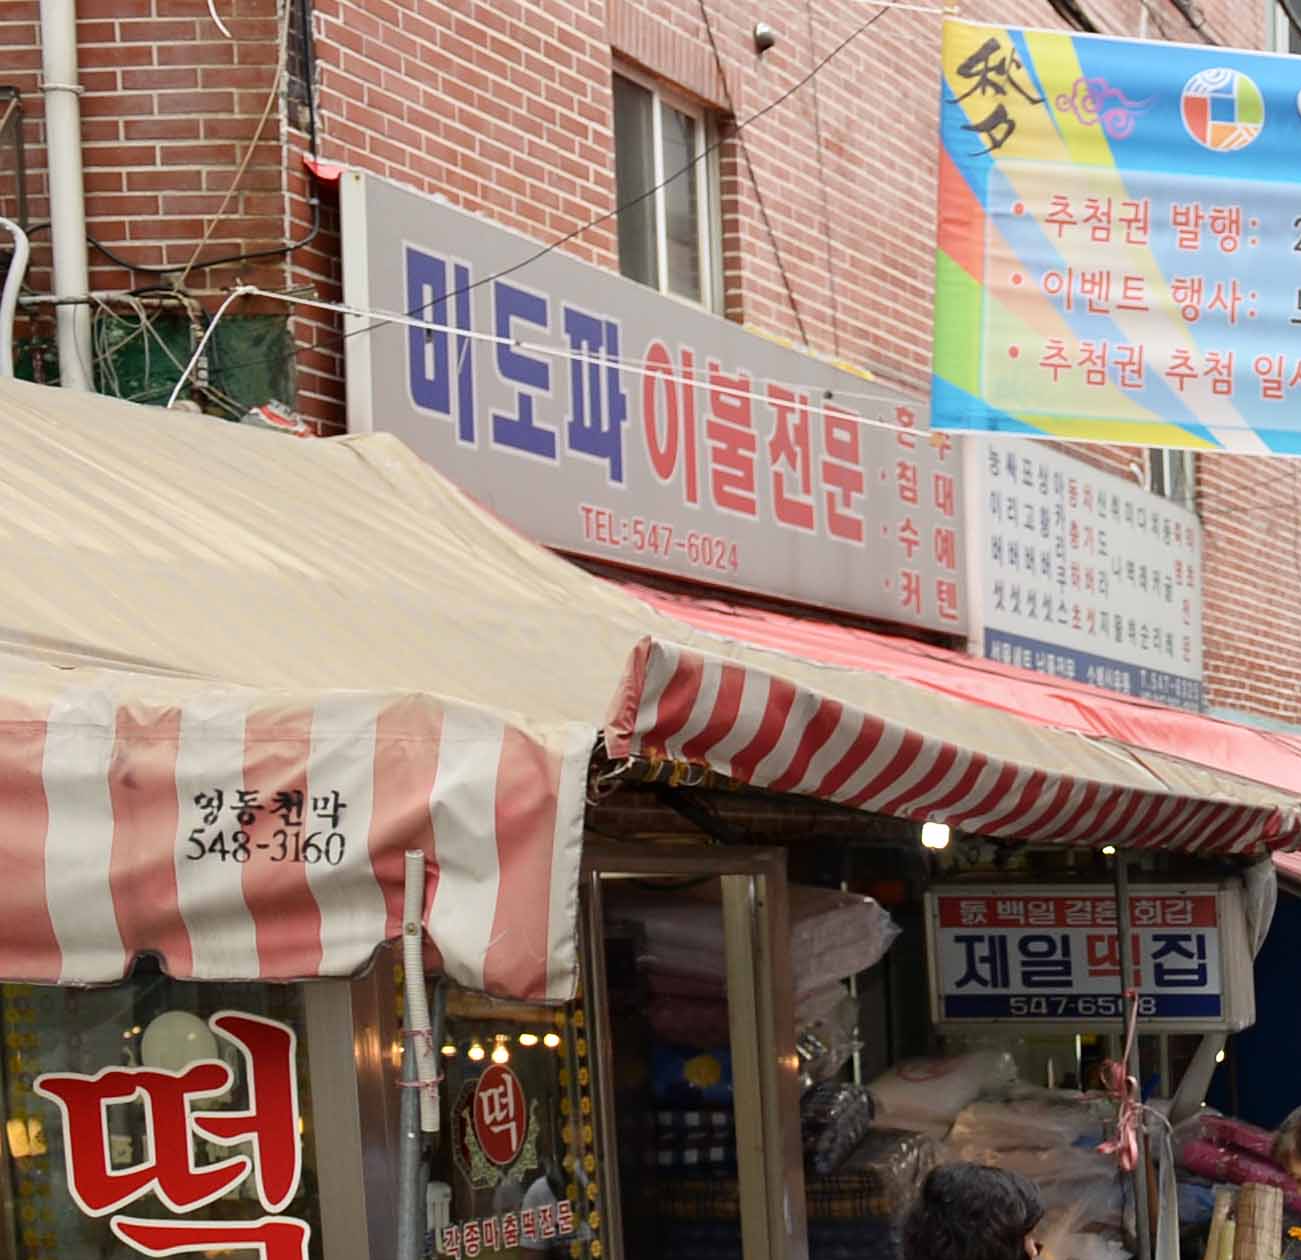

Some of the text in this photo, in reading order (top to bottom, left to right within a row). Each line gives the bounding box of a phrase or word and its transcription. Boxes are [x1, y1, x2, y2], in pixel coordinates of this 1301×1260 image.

[1045, 194, 1150, 245] 추첨권
[1172, 205, 1259, 255] 발행:
[1043, 270, 1148, 315] 이벤트
[1172, 280, 1255, 322] 행사:
[406, 248, 866, 543] 미도파 이불전문
[1040, 339, 1144, 389] 추첨권
[1167, 349, 1233, 396] 추첨
[581, 506, 740, 572] TEL:547-6024
[193, 787, 348, 829] 영동천막
[186, 829, 347, 867] 548-3160
[996, 898, 1057, 925] 백일
[1063, 899, 1119, 925] 결혼
[1134, 899, 1195, 926] 회갑
[954, 933, 1208, 989] 제일떡집
[1009, 997, 1157, 1015] 547-658
[479, 1073, 517, 1153] 떡
